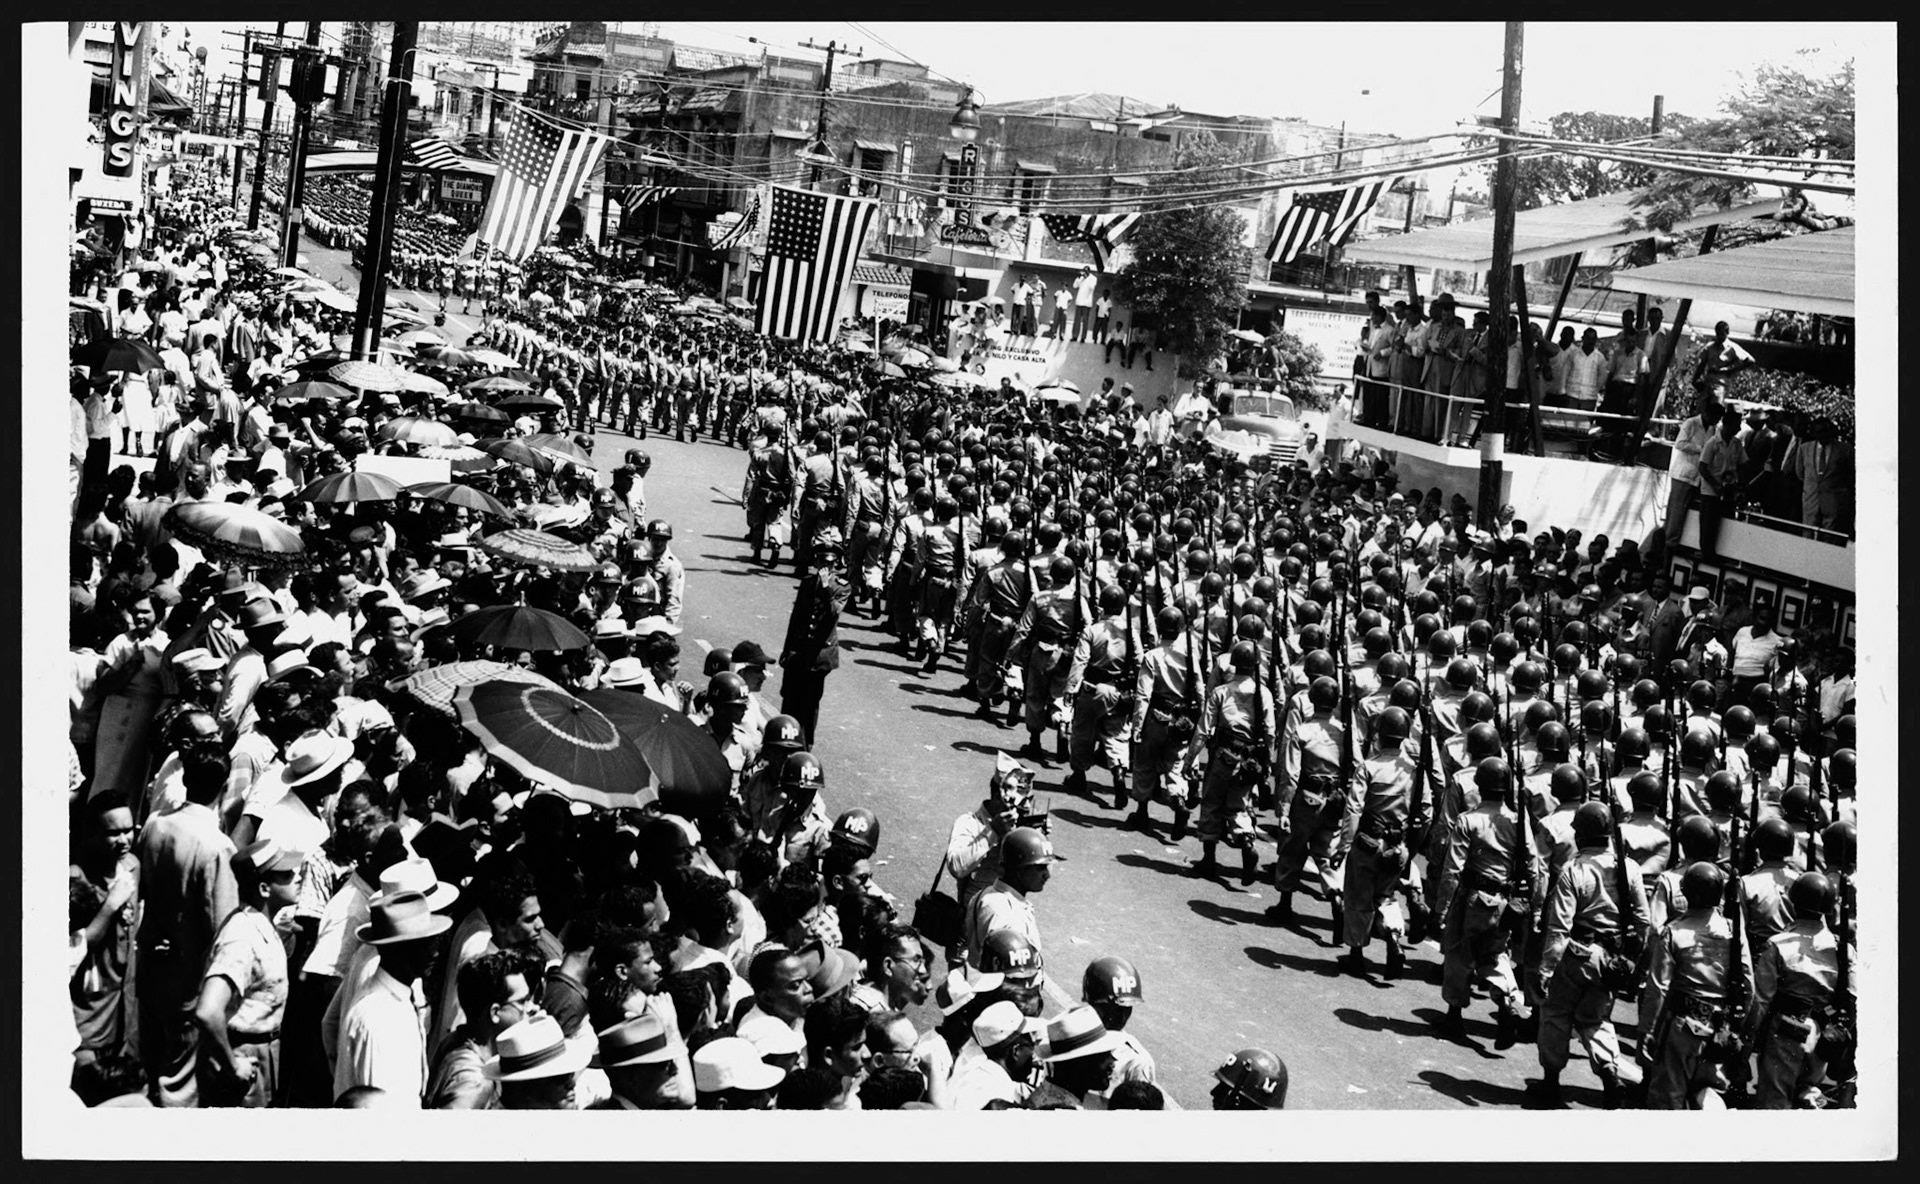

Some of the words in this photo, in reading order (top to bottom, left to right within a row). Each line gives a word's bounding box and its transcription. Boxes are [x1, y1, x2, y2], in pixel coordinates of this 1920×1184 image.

[109, 21, 143, 167] VINGS
[872, 290, 910, 300] TELEFONO
[1005, 345, 1040, 356] EXCLUSIVO
[632, 583, 648, 595] MP
[781, 723, 799, 740] MP
[801, 761, 820, 780] MP
[844, 816, 869, 833] MP
[1008, 948, 1032, 967] MP
[1112, 974, 1137, 994] MP
